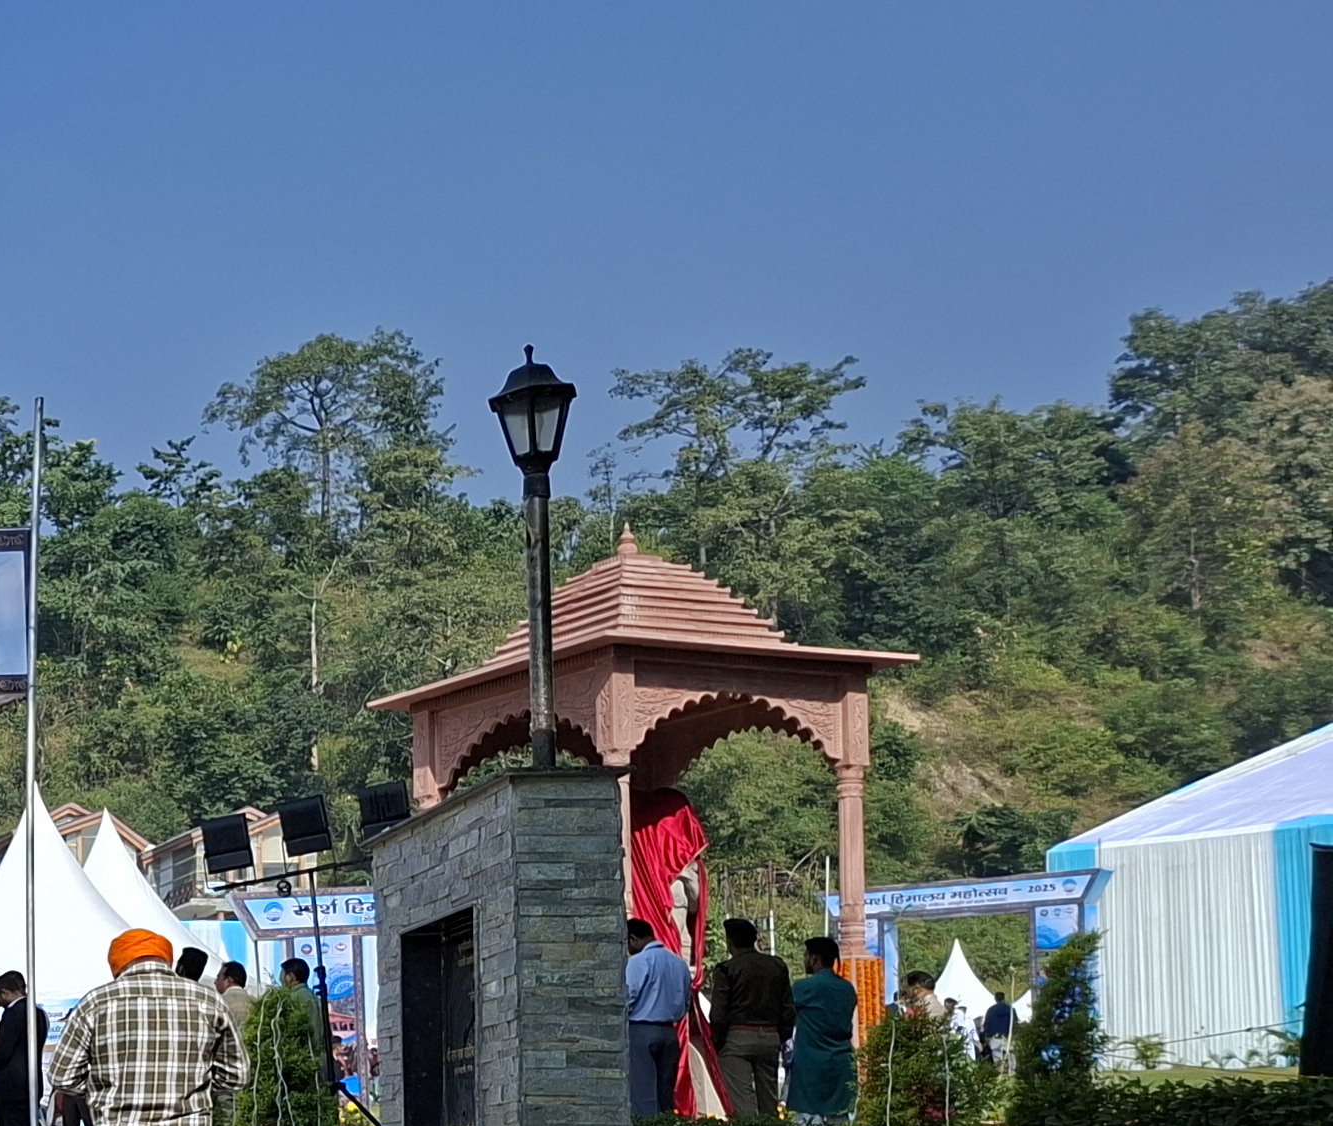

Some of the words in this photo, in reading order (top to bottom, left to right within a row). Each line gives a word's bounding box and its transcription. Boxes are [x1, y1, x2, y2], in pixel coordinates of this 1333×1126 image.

[891, 892, 946, 905] हिमालय
[950, 887, 1008, 900] महोत्सव
[1027, 883, 1056, 893] 2025
